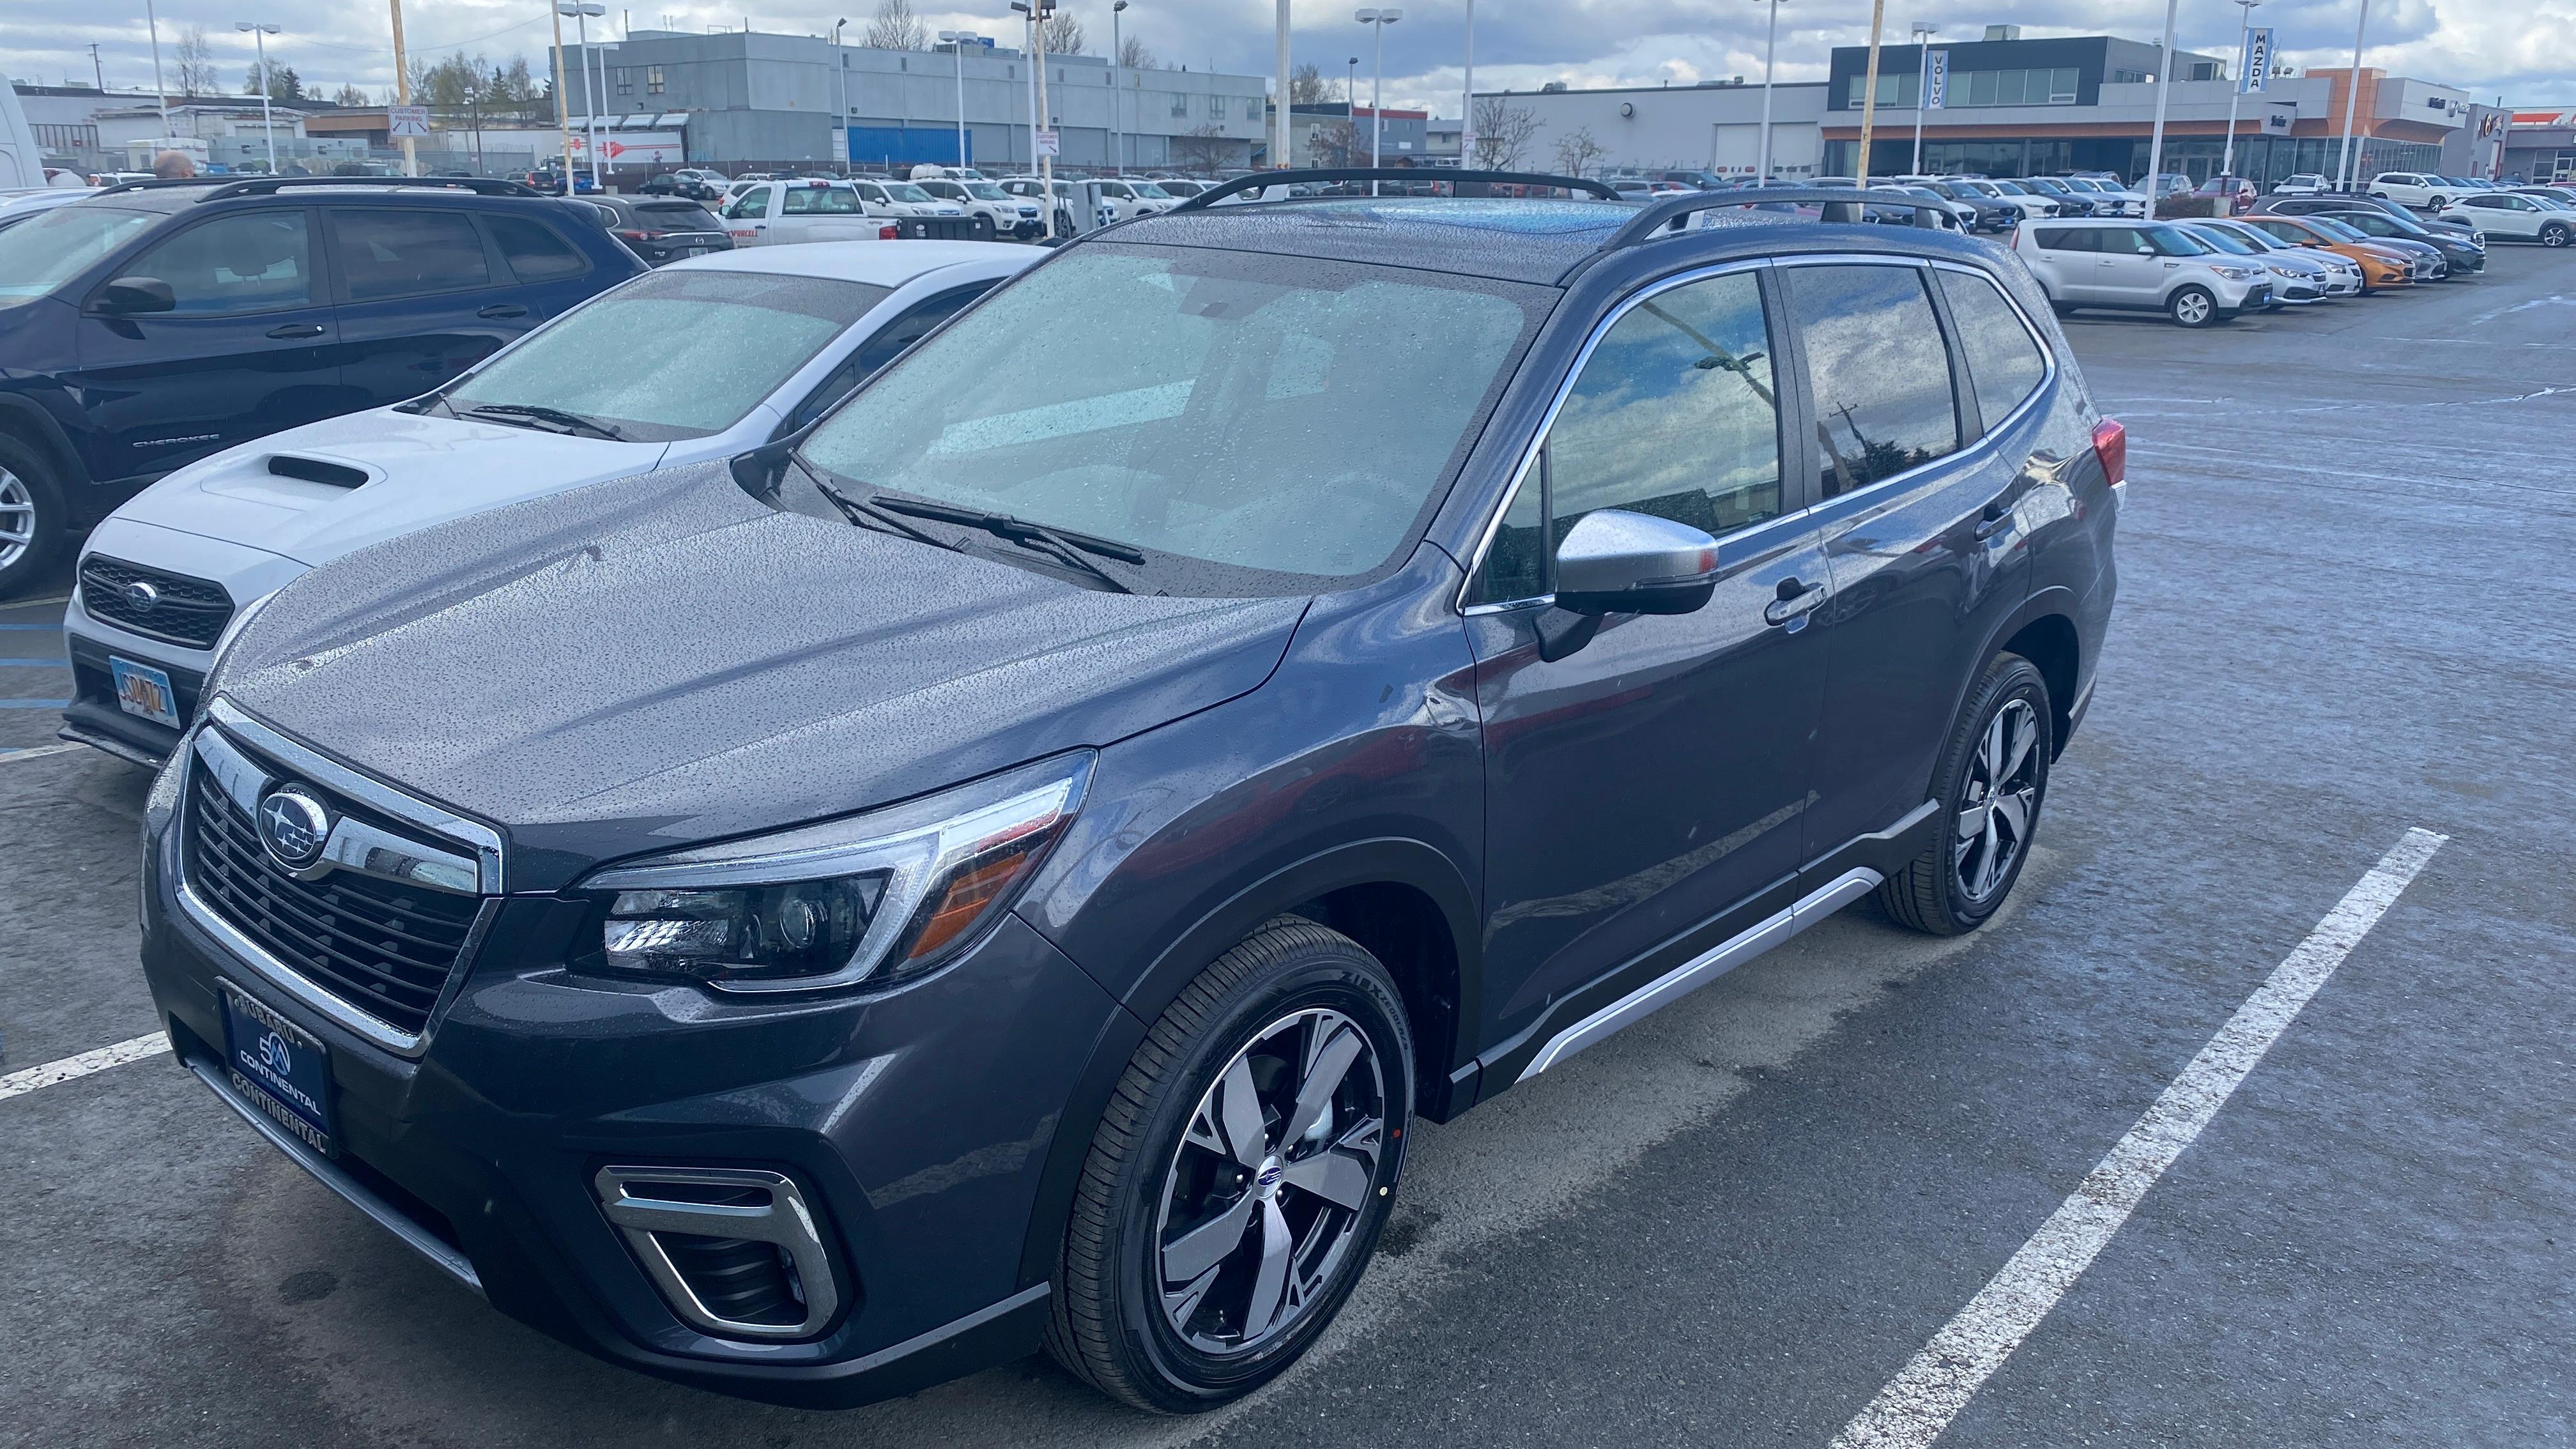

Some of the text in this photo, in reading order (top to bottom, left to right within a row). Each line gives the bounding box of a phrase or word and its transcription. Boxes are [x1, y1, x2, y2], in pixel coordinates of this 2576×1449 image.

[1931, 56, 1943, 105] VOLVO
[2250, 34, 2266, 88] MAZDA
[133, 434, 220, 447] CHEROKEE
[238, 995, 295, 1044] SUBARU
[240, 1050, 321, 1116] CONTINENTAL
[232, 1073, 326, 1153] CONTINENTAL
